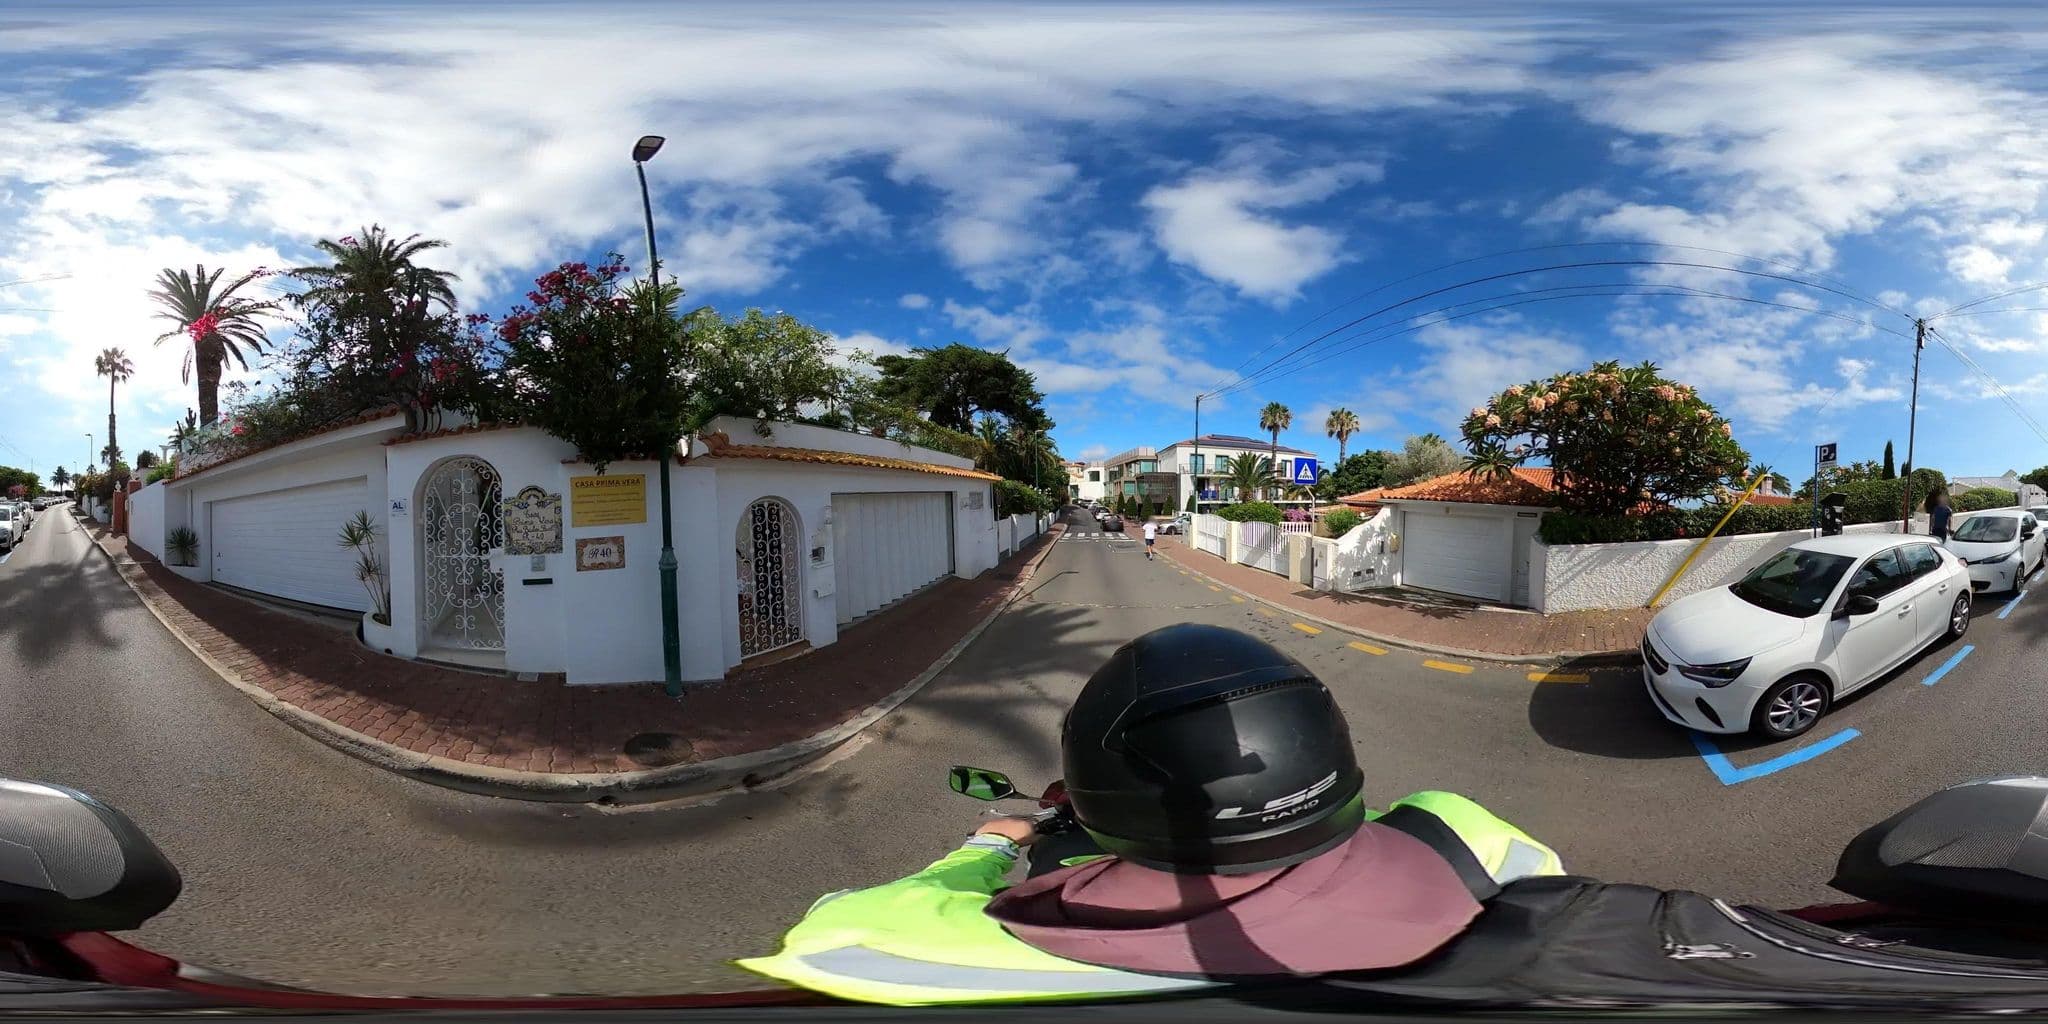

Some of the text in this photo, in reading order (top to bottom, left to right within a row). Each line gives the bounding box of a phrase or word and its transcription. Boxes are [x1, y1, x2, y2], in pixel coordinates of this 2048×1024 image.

[1821, 447, 1829, 460] P
[575, 478, 641, 488] CASA PRIMA VERA
[392, 501, 404, 509] AL
[600, 547, 612, 558] 40
[1215, 770, 1337, 819] LS2
[1262, 799, 1319, 822] RAPID
